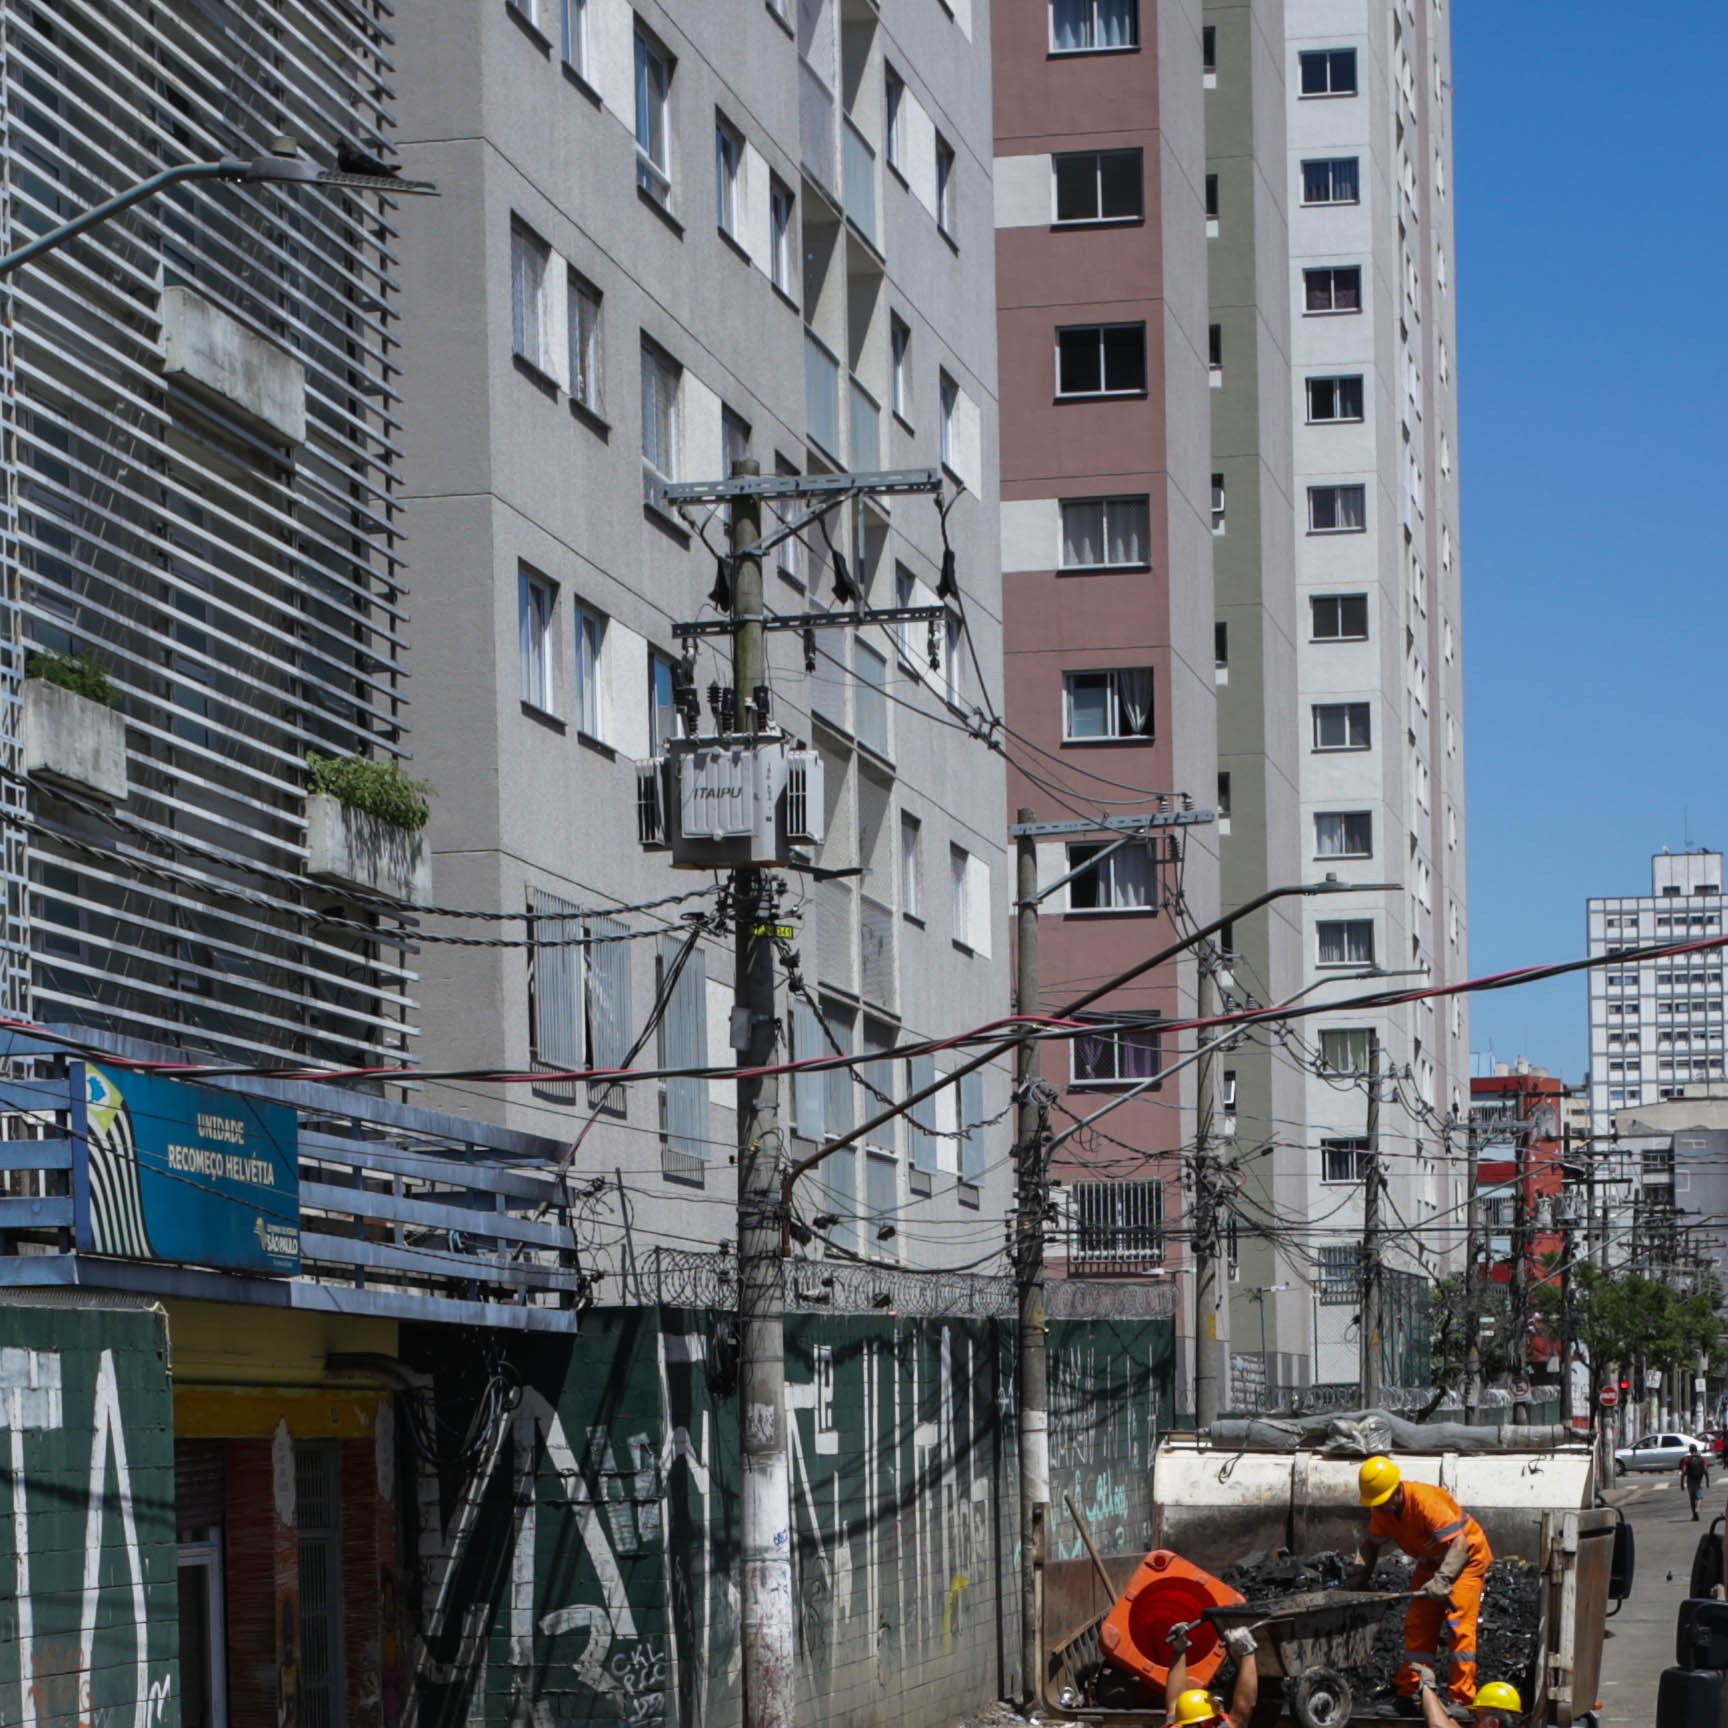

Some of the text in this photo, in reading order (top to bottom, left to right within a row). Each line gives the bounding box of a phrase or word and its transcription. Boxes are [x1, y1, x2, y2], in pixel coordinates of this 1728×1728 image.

[694, 786, 742, 800] ITAIPU
[197, 1112, 245, 1145] UNIDADE
[167, 1144, 275, 1185] RECOMEÇO HELVÉTIA
